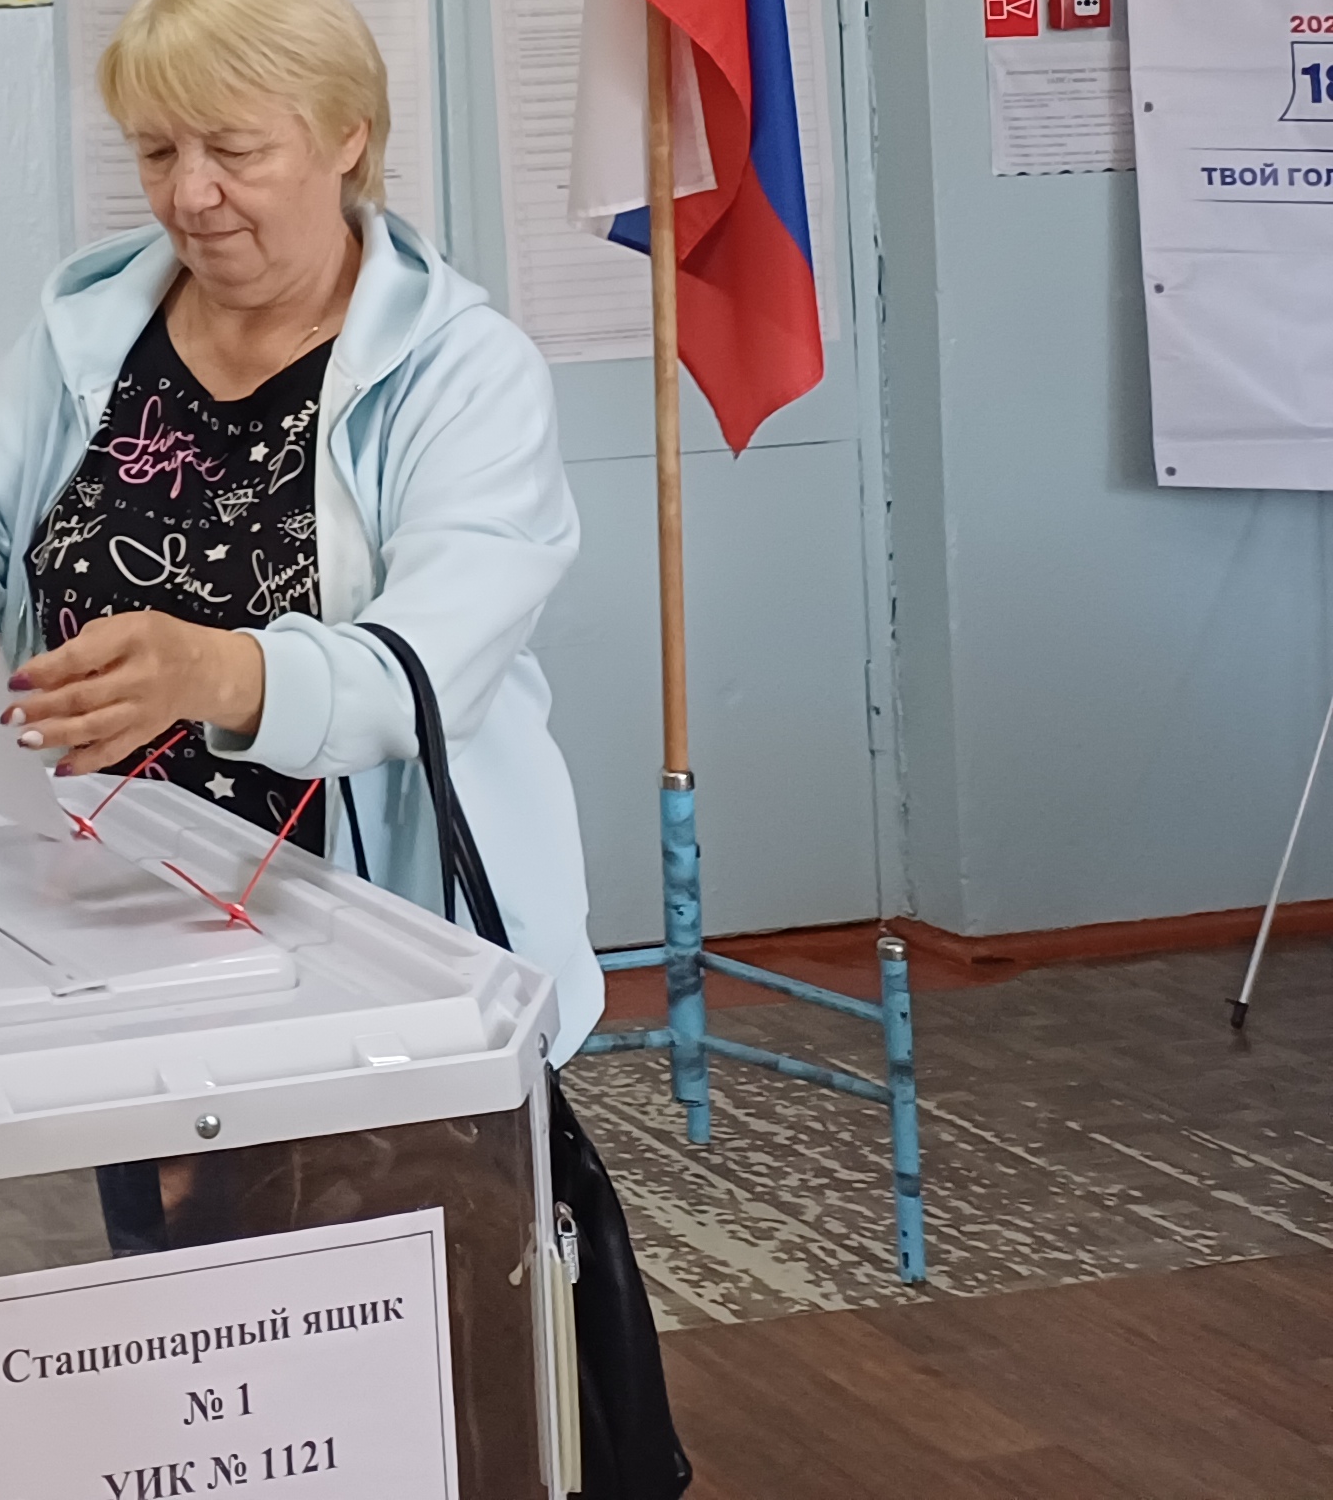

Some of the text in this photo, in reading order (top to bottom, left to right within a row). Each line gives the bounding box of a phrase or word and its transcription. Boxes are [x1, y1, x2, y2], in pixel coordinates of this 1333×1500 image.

[1200, 162, 1279, 187] ТВОЙ
[1, 1297, 405, 1383] Стационарный ящик
[183, 1382, 253, 1426] № 1
[101, 1436, 339, 1500] УИК № 1121
